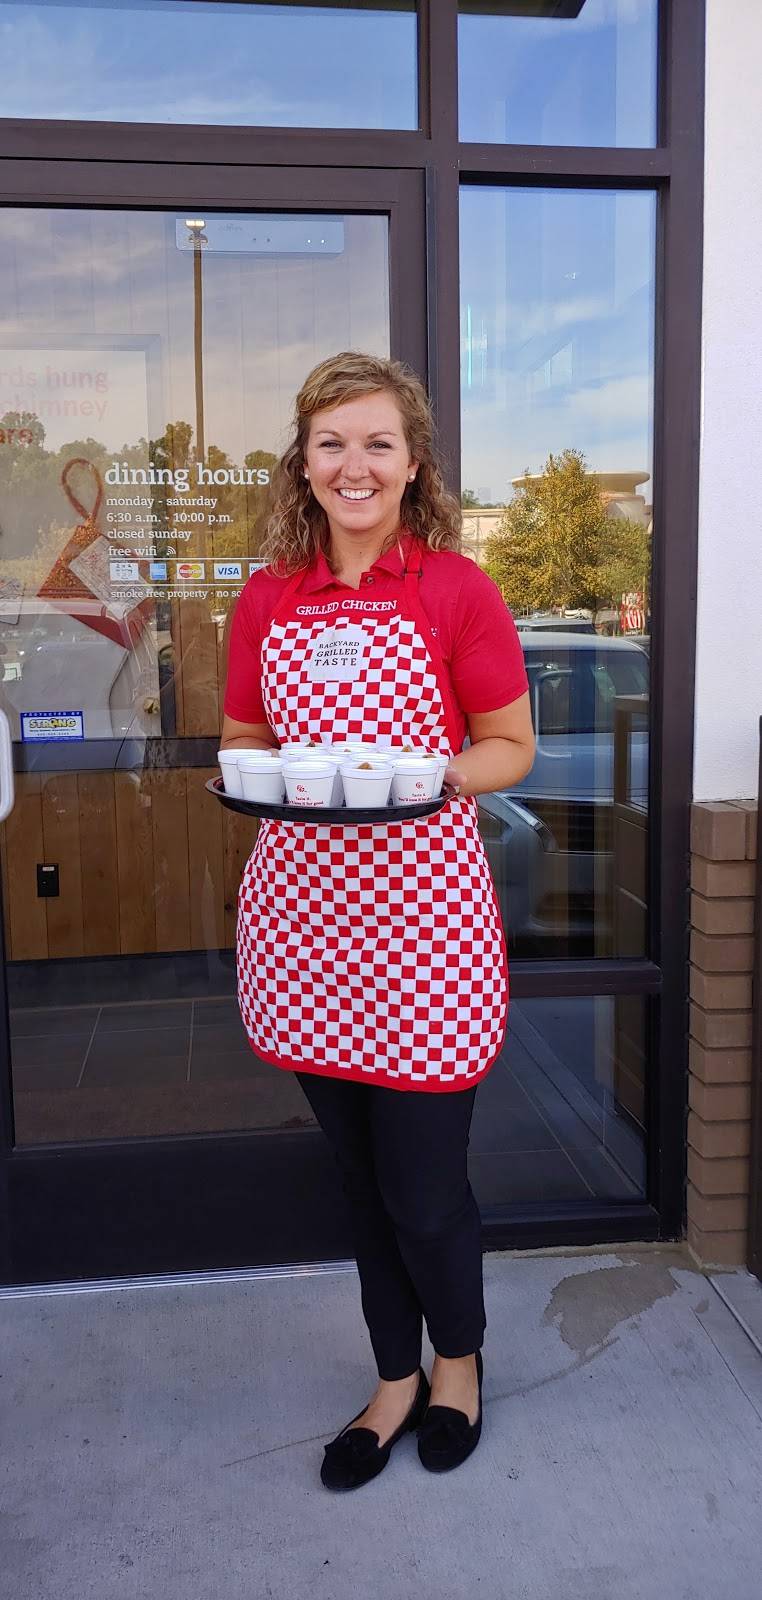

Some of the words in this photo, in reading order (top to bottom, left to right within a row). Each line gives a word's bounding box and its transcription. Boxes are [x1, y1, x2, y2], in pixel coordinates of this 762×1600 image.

[45, 365, 109, 394] hung
[105, 462, 190, 492] dining
[196, 462, 270, 485] hours
[106, 496, 154, 508] monday
[166, 496, 218, 508] saturday
[106, 512, 132, 522] 6:30
[135, 514, 161, 522] a.m.
[173, 512, 205, 522] 10:00
[208, 514, 234, 525] p.m.
[107, 528, 145, 539] closed
[148, 528, 192, 541] sunday
[108, 545, 131, 556] free
[134, 545, 157, 556] wifi
[218, 567, 240, 575] VISA
[111, 589, 143, 598] smoke
[146, 589, 165, 598] free
[168, 590, 208, 599] property
[216, 590, 229, 598] no
[296, 602, 339, 615] GRILLED
[341, 600, 397, 612] CHICKEN
[319, 640, 360, 649] BACKYARD
[316, 648, 358, 657] GRILLED
[314, 657, 357, 666] TASTE
[30, 718, 76, 728] STRONG
